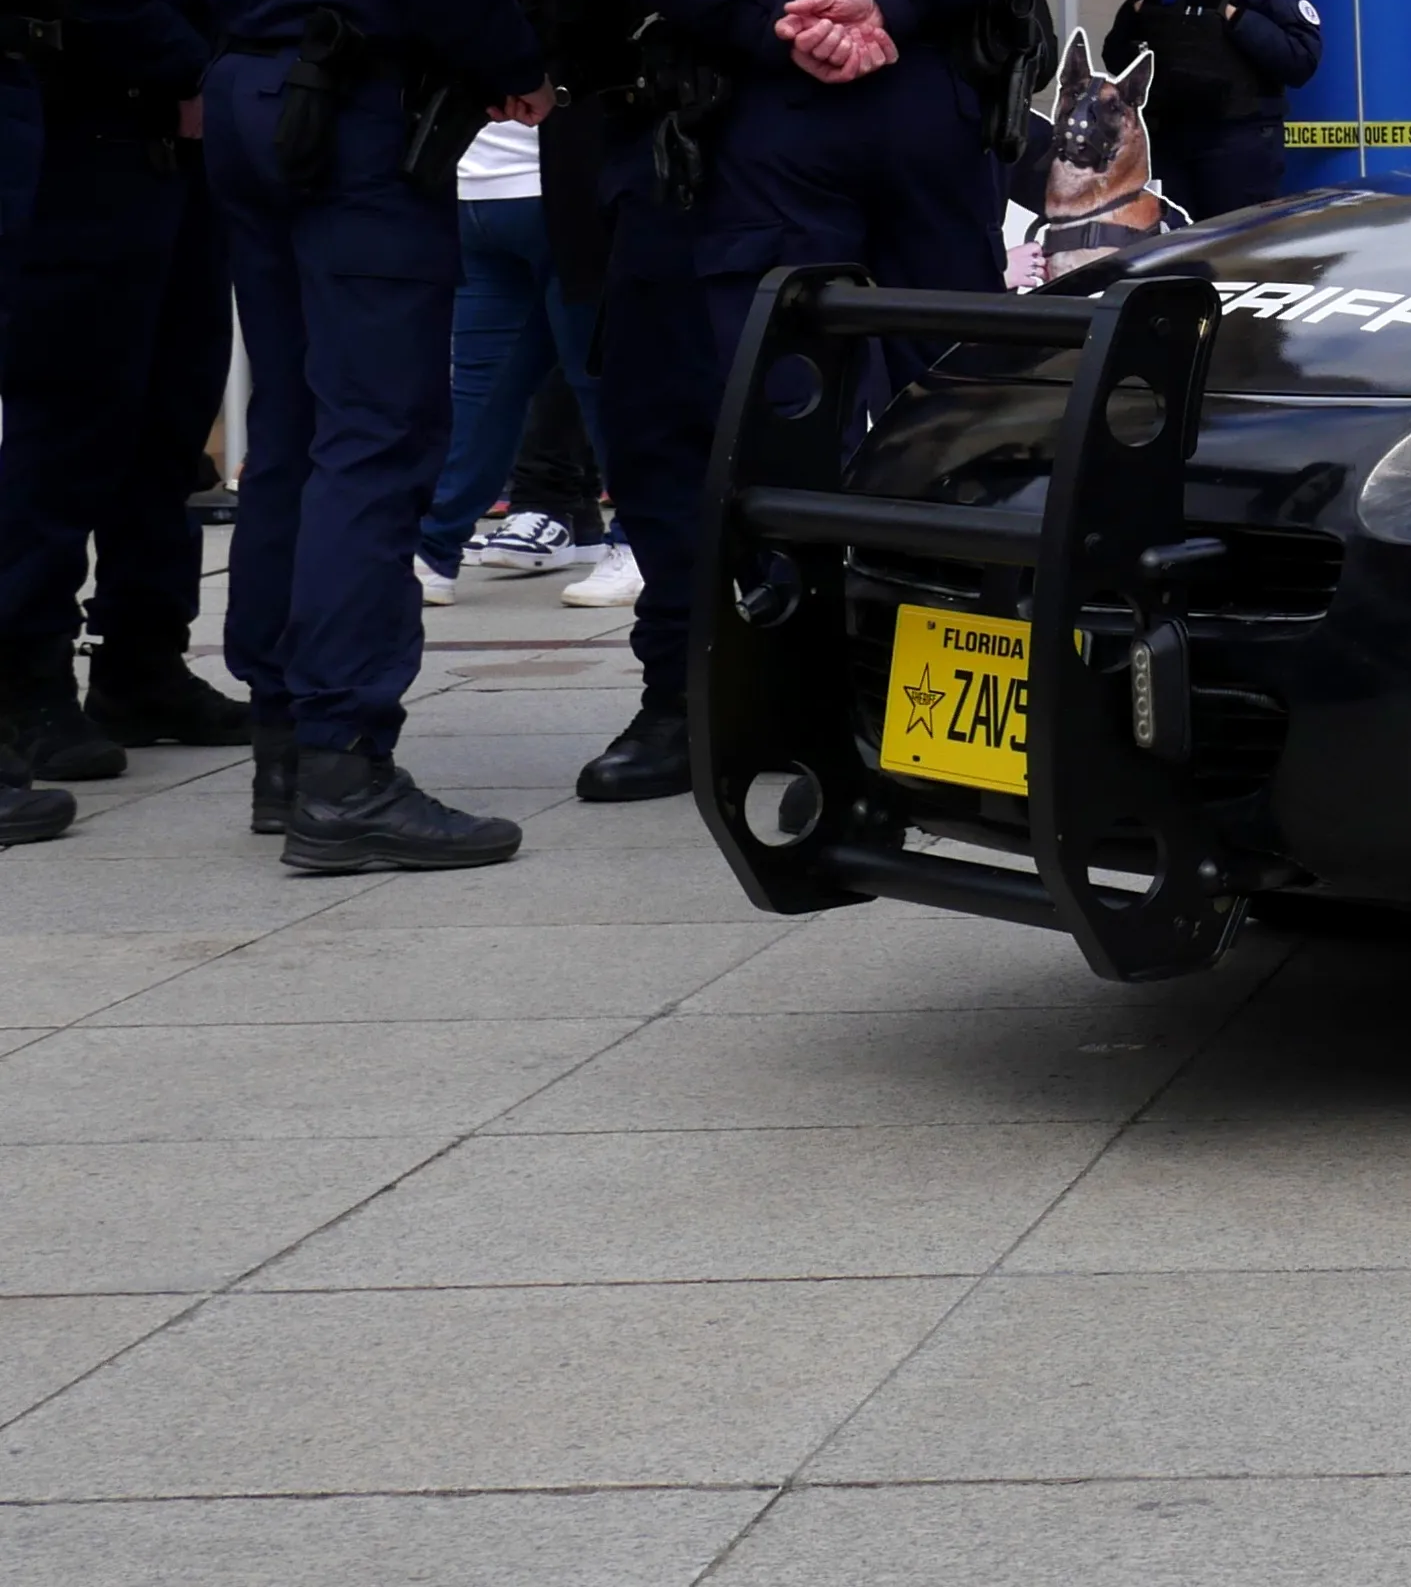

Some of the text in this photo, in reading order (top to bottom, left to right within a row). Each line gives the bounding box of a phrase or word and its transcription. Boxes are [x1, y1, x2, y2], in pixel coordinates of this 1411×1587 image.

[1284, 127, 1318, 144] OLICE
[1322, 127, 1388, 144] TECHNQUE
[1392, 127, 1405, 144] ET
[943, 627, 1024, 659] FLORIDA
